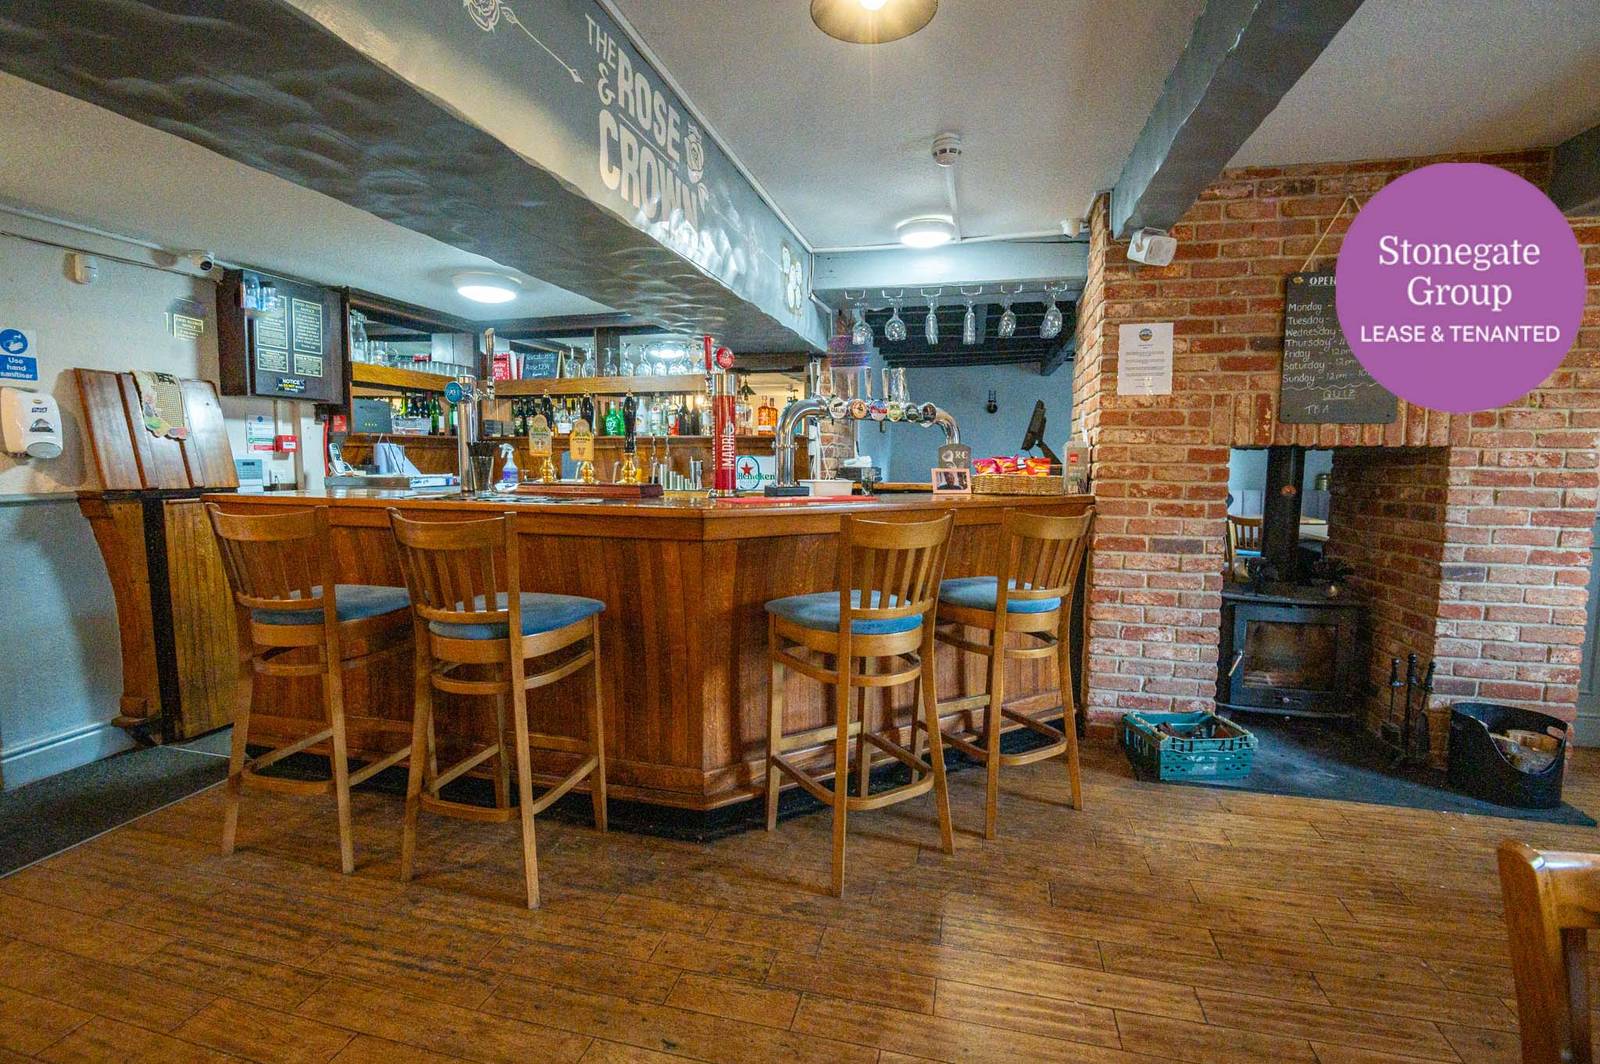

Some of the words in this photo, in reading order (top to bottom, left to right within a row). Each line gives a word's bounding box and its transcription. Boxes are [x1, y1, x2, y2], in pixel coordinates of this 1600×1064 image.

[585, 12, 616, 70] THE
[598, 62, 616, 106] &
[618, 47, 680, 163] ROSE
[599, 109, 698, 231] CROWN
[1288, 302, 1323, 316] Monday
[1287, 316, 1324, 329] Tuesday
[1286, 327, 1336, 340] Wednesday
[1285, 338, 1331, 352] Thursday
[1284, 349, 1311, 362] Friday
[1284, 360, 1325, 374] Saturday
[1282, 373, 1315, 388] Sunday
